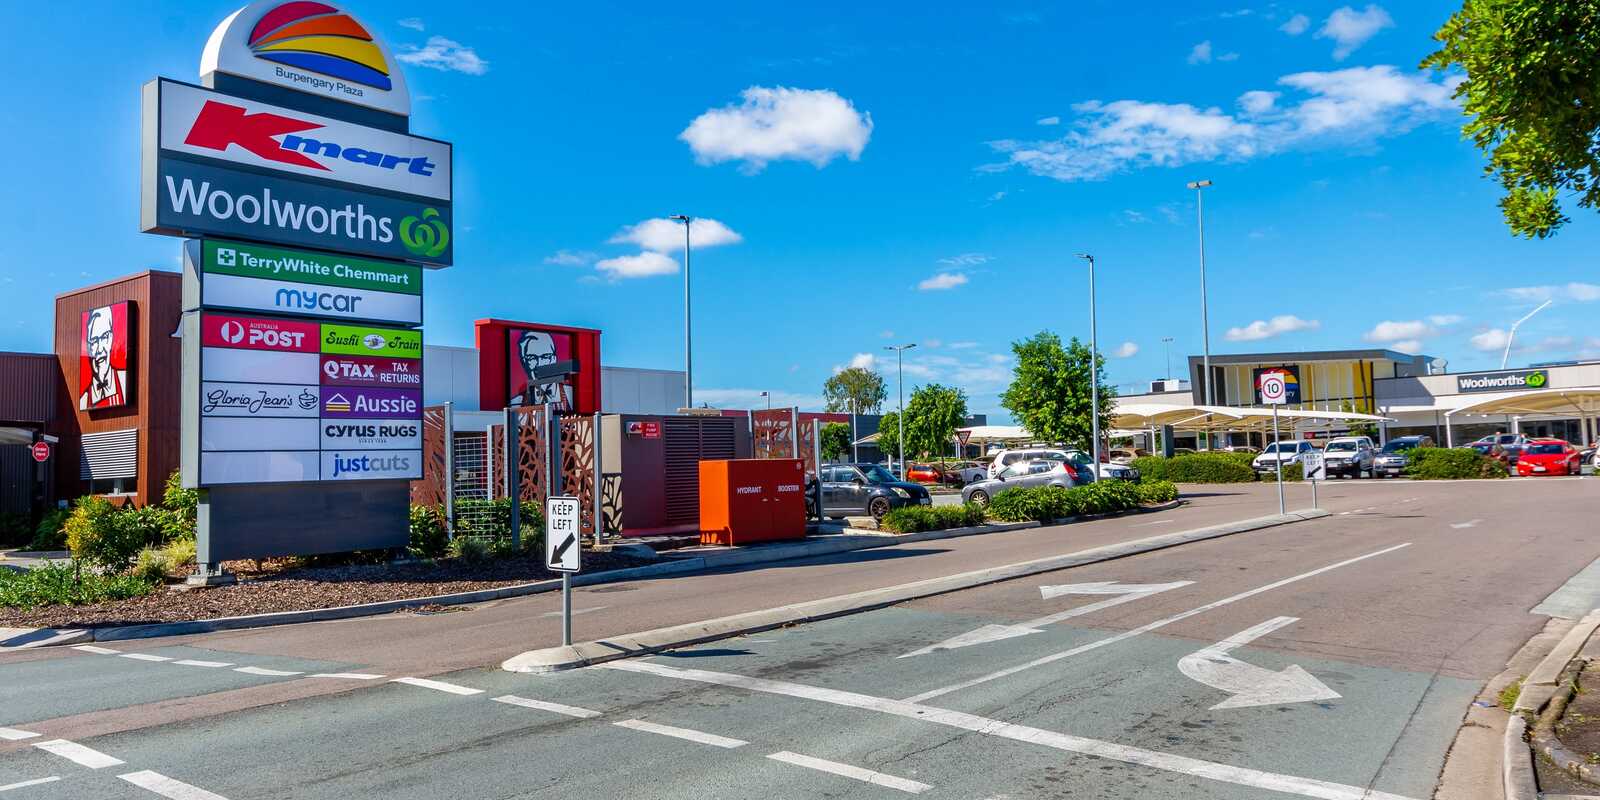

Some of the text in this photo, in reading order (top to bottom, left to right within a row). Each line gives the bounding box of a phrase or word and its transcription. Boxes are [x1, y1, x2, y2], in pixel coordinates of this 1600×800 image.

[276, 66, 364, 97] Burpengary Plaza
[184, 100, 436, 177] Kmart
[166, 175, 394, 243] Woolworths
[240, 252, 409, 285] TerryWhite Chemmart
[275, 288, 362, 312] mycar
[249, 322, 279, 330] AUSTRALIA
[249, 329, 305, 347] POST
[326, 331, 420, 350] Sushi Train
[392, 362, 409, 372] TAX
[380, 373, 420, 384] RETURNS
[1460, 375, 1525, 389] Woolworths
[1267, 383, 1279, 394] 10
[203, 389, 293, 413] Gloria Jean's
[354, 395, 417, 413] Aussie
[379, 425, 417, 437] RUGS
[736, 486, 762, 494] HYDRANT
[552, 504, 574, 516] KEEP
[552, 520, 572, 530] LEFT
